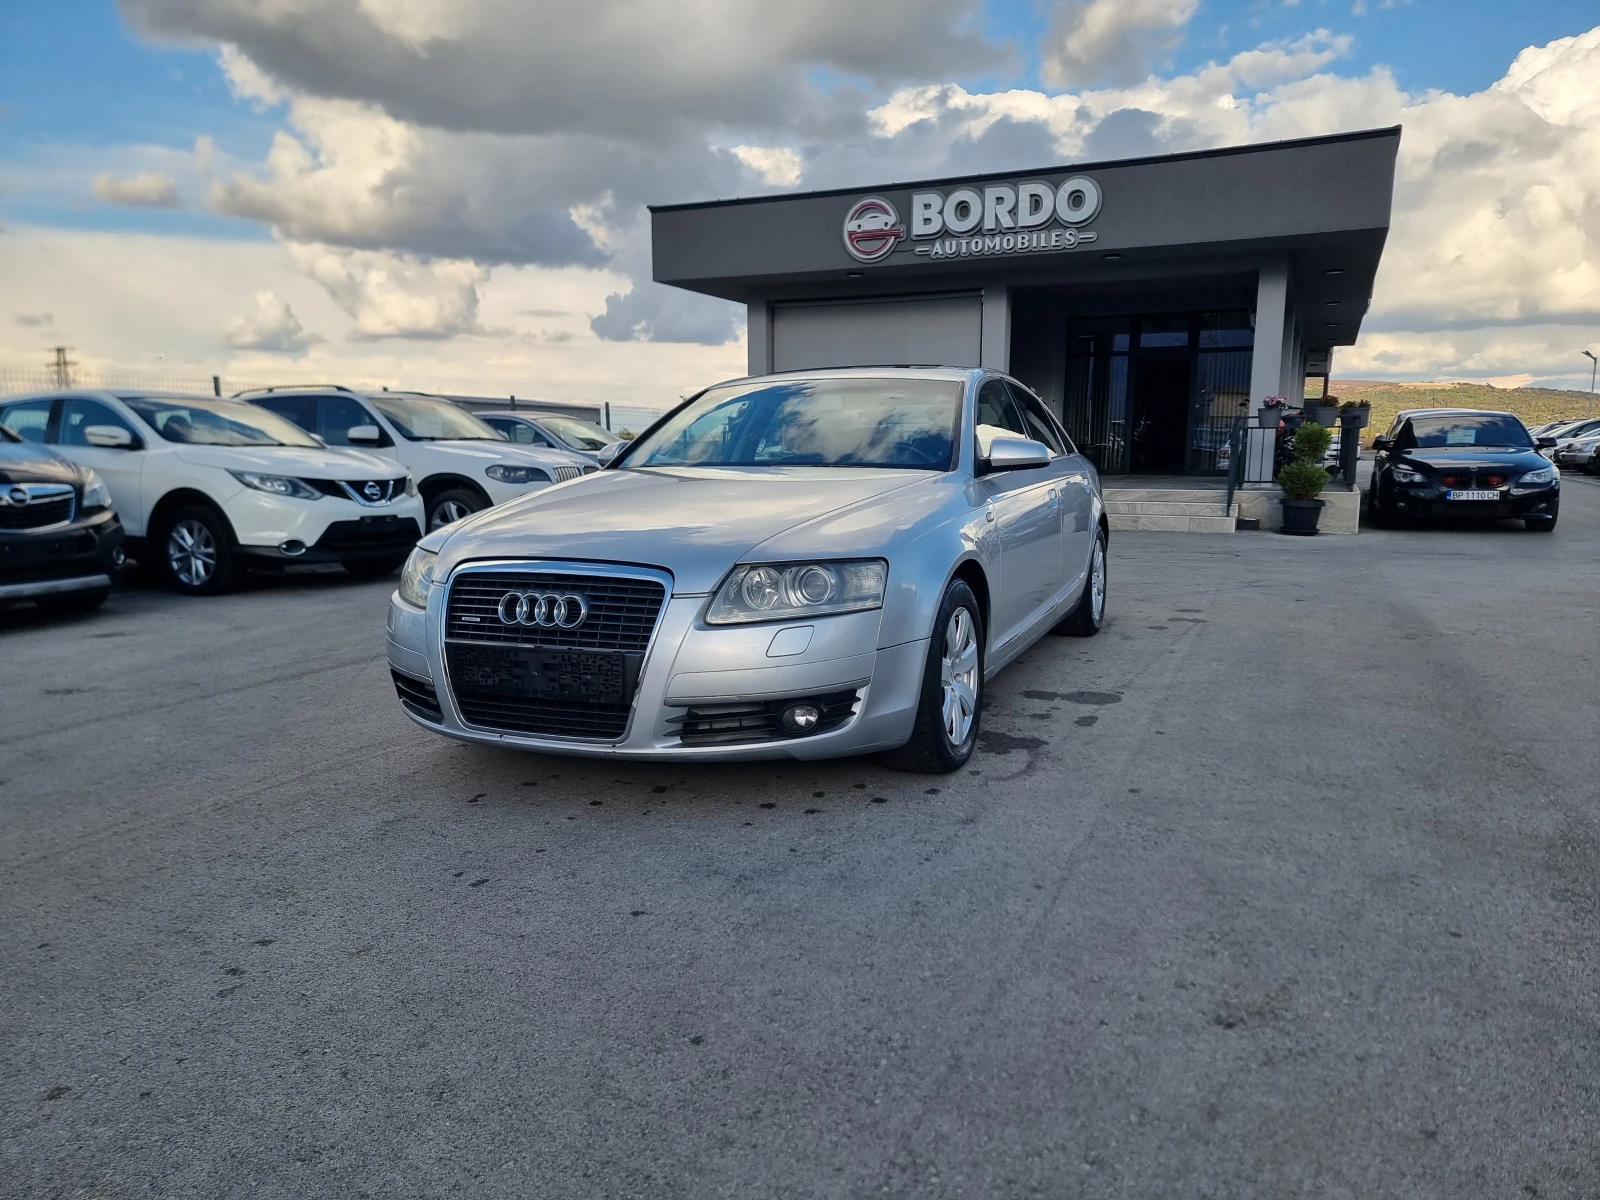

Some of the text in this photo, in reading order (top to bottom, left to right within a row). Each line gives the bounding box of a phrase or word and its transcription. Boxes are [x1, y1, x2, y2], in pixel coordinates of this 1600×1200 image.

[912, 178, 1099, 236] BORDO
[932, 230, 1076, 256] AUTOMOBILES
[1452, 491, 1464, 499] BP
[1466, 491, 1486, 499] 1110
[1487, 491, 1499, 499] CH
